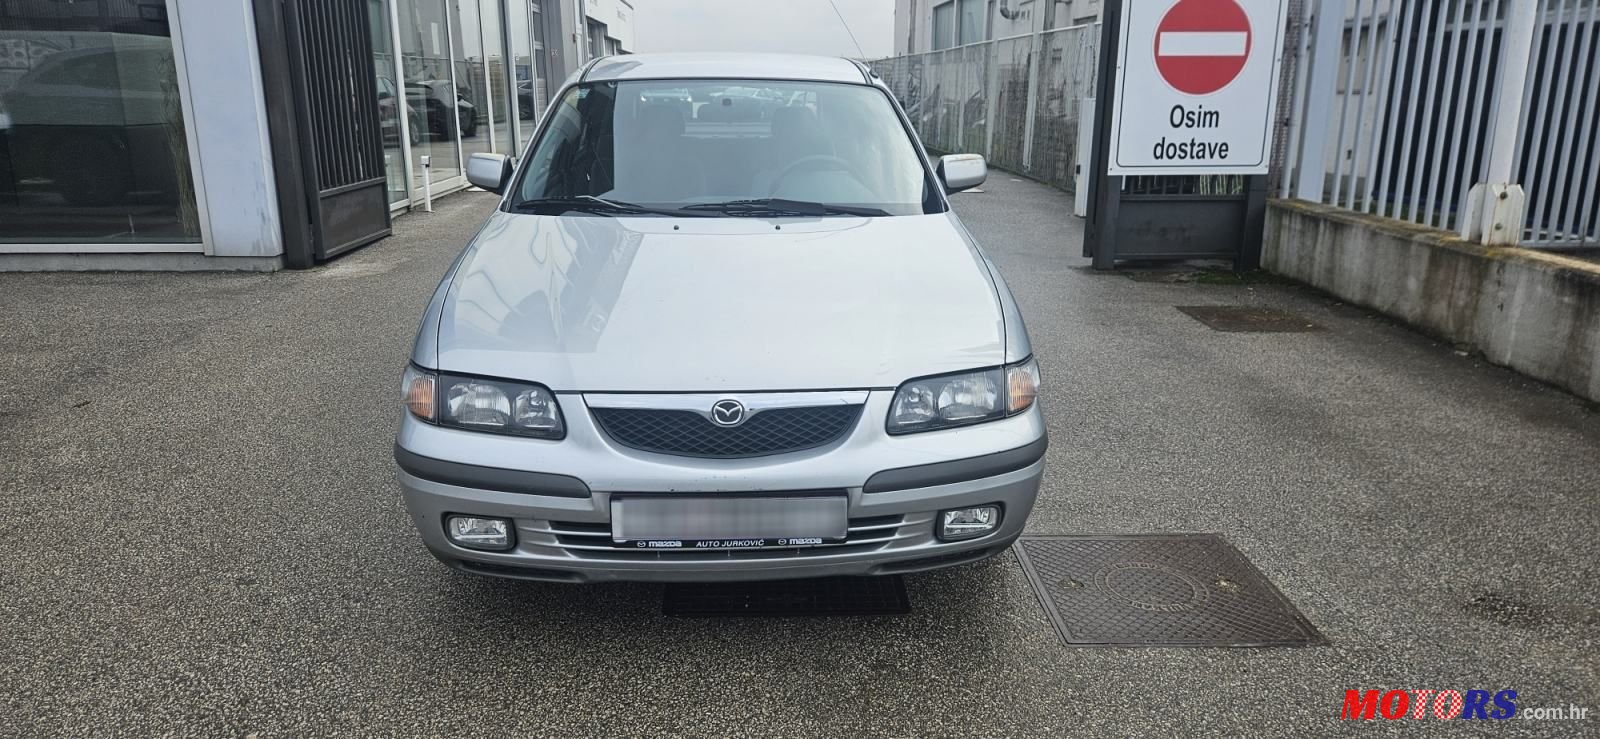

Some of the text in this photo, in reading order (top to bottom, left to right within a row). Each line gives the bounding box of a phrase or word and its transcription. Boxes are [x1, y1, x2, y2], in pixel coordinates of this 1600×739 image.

[1170, 104, 1220, 128] Osim
[1153, 136, 1229, 160] dostave
[721, 539, 764, 547] JURKOVIĆ
